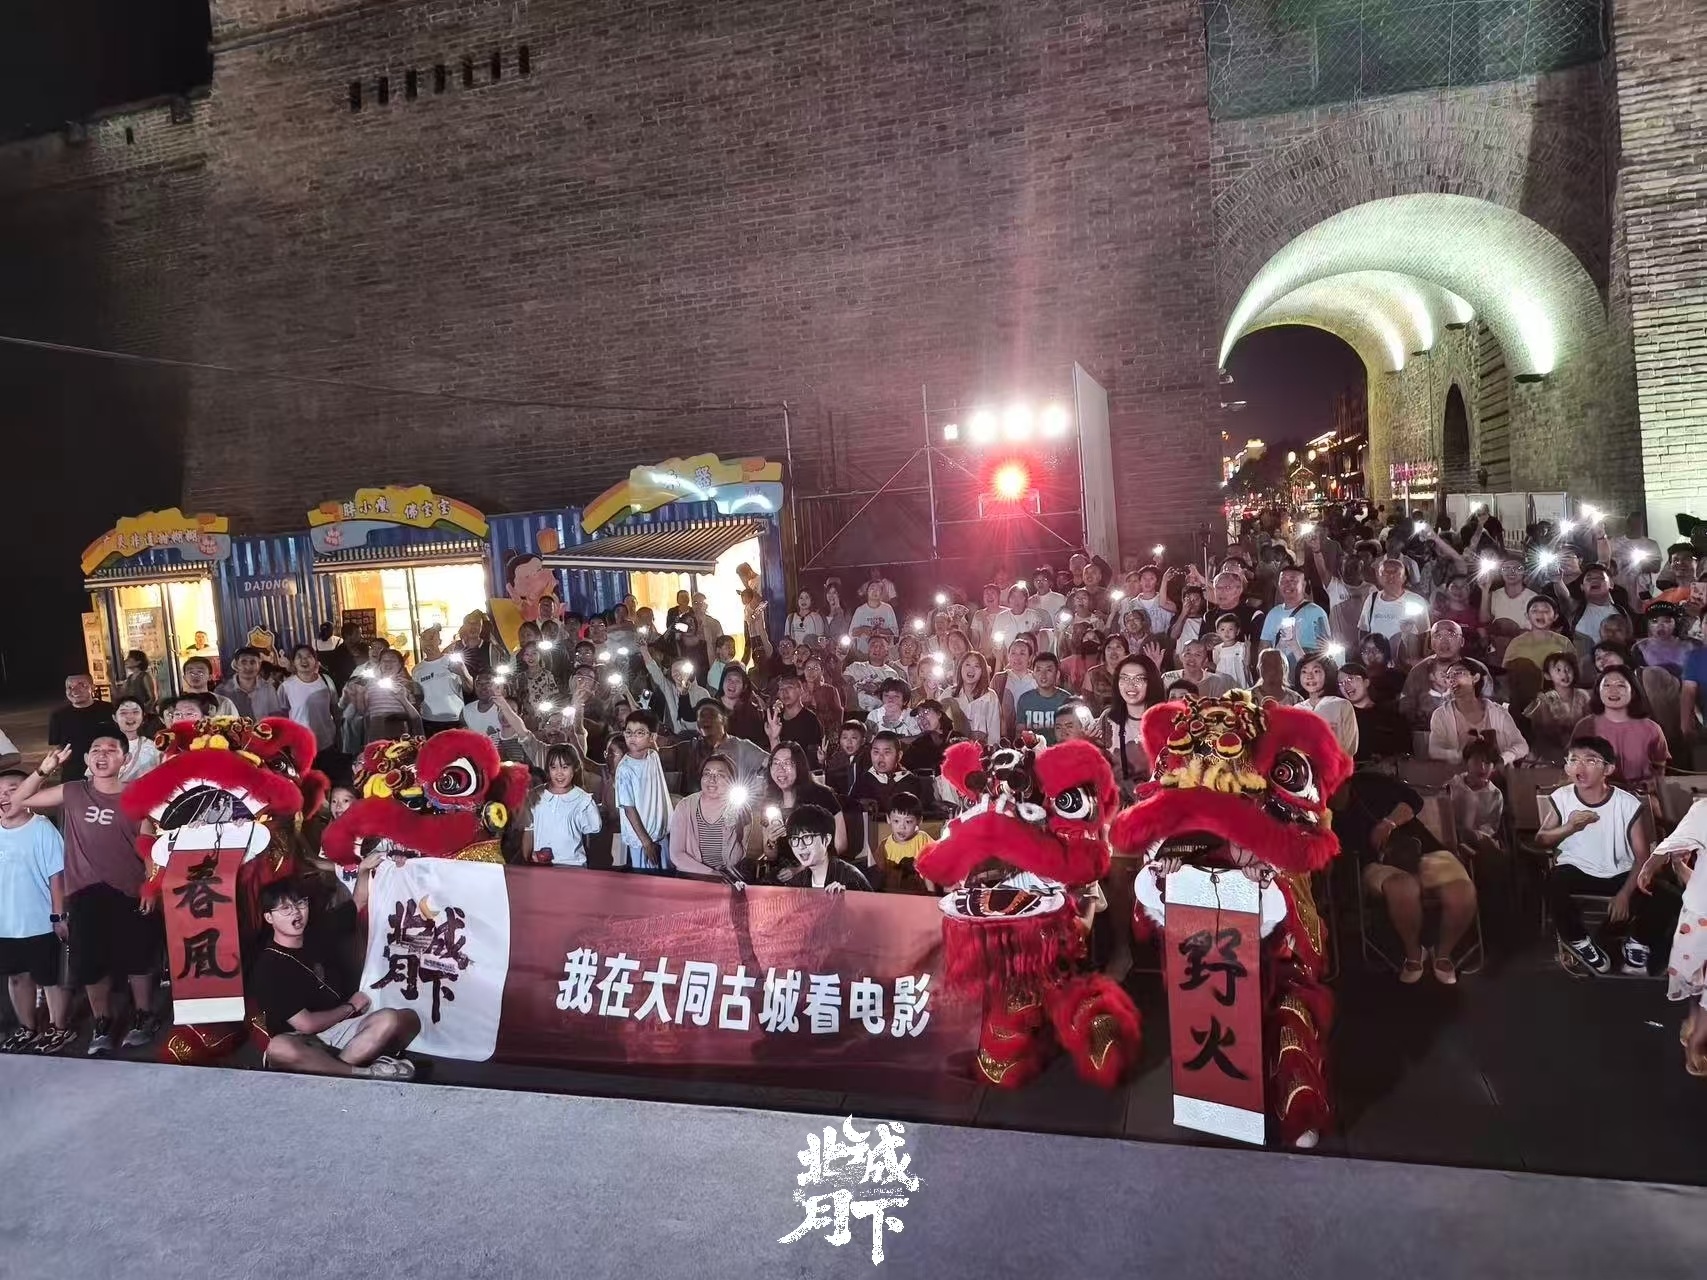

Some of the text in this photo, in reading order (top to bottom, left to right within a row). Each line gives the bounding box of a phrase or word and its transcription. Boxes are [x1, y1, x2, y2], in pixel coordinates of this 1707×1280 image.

[244, 579, 289, 591] DATONG
[556, 947, 932, 1037] 我在大同古城看电影
[1178, 928, 1249, 1080] 野火
